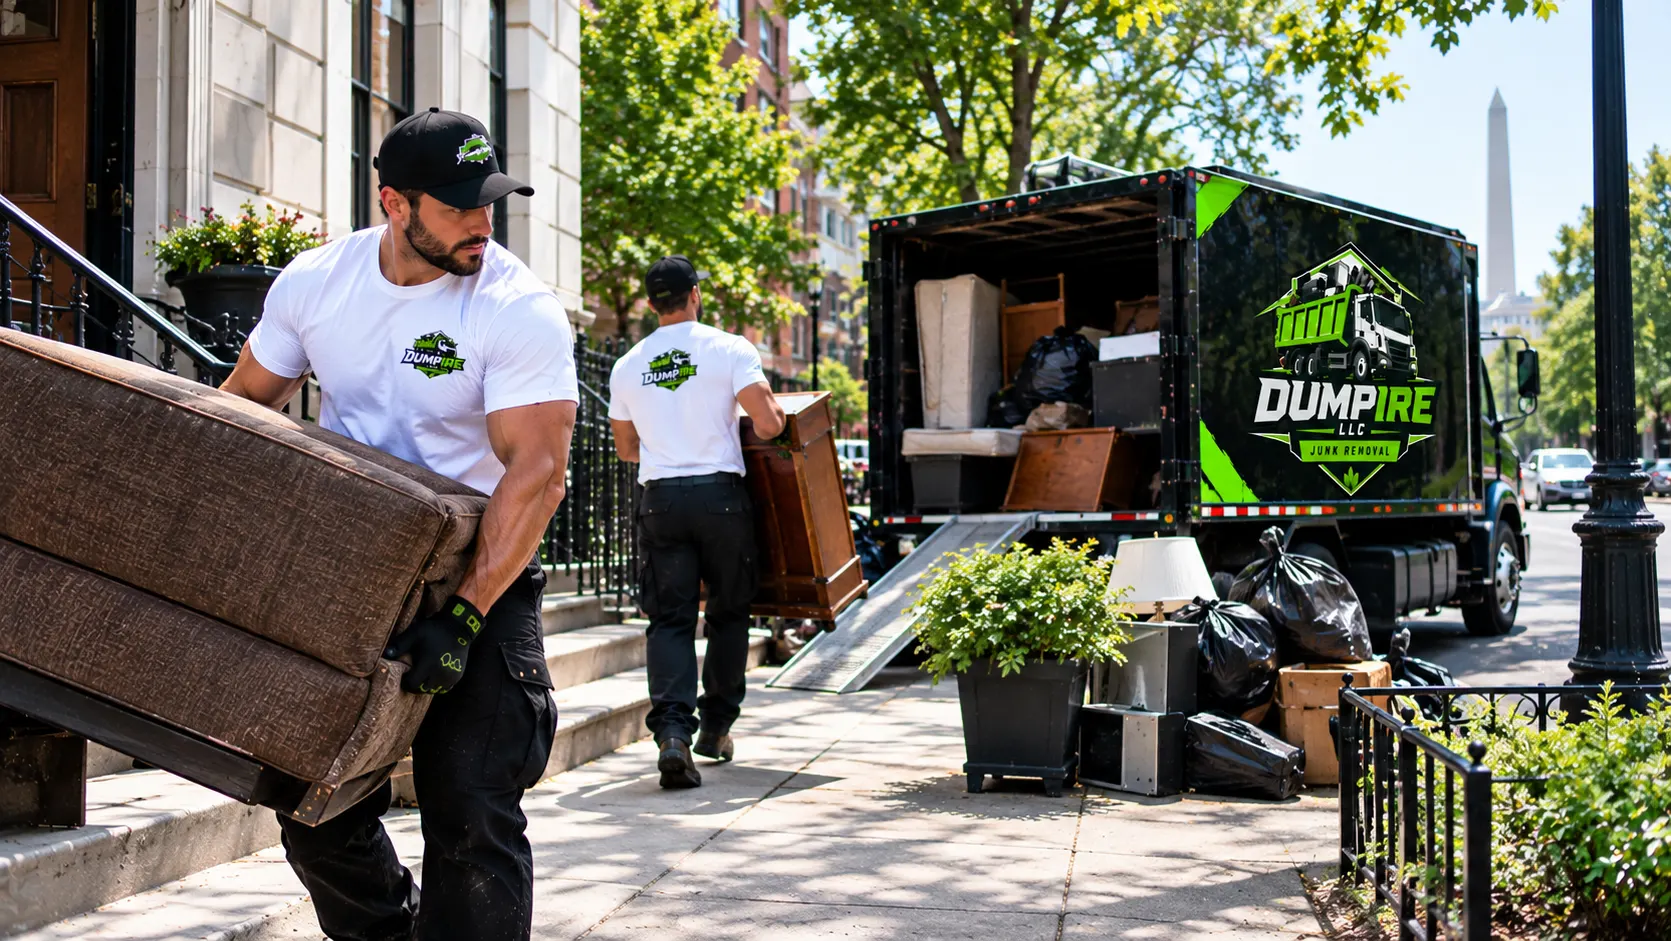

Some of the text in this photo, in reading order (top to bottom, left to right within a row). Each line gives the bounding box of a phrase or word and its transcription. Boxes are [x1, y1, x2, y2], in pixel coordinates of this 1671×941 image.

[1253, 377, 1437, 424] DUMPIRE
[1338, 422, 1366, 436] LLC
[1309, 445, 1390, 456] JUNK REMOVAL
